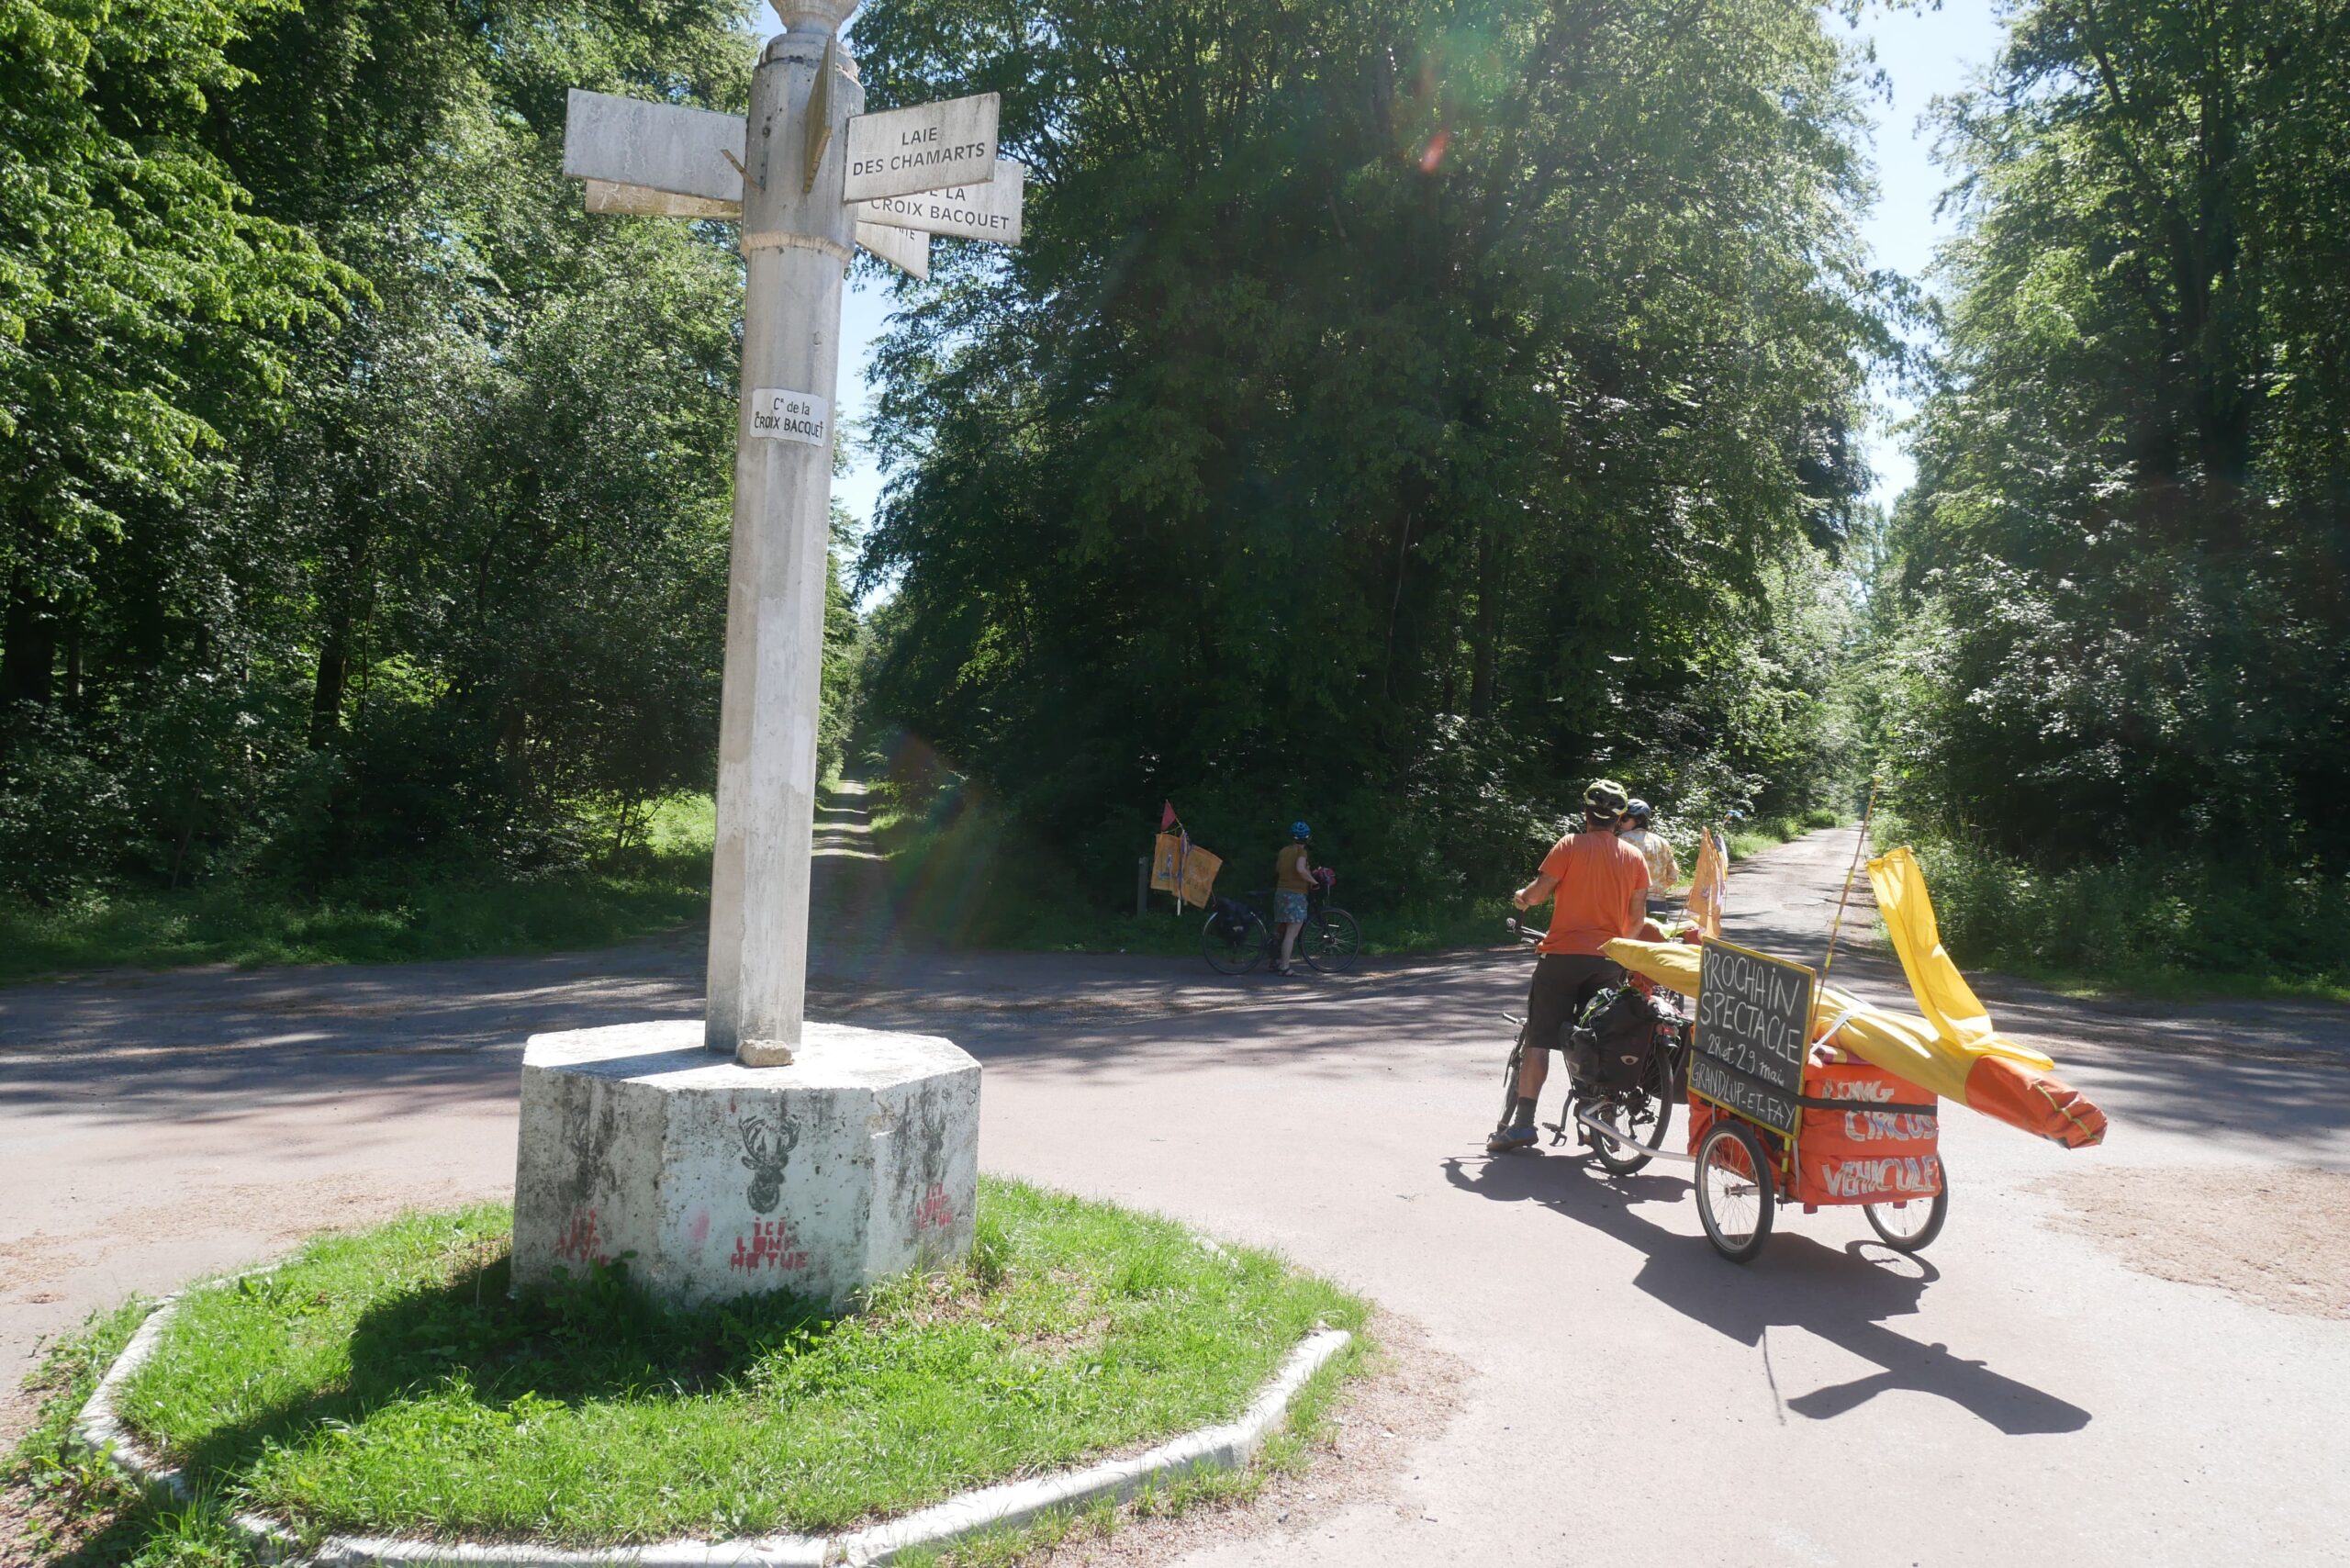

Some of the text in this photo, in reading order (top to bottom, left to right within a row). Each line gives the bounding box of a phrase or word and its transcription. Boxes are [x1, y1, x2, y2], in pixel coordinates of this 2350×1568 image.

[901, 127, 938, 146] LAIE
[853, 142, 985, 176] DES CHAMARTS
[946, 187, 967, 202] LA
[871, 197, 1010, 230] CROIX BACQUET
[787, 401, 800, 414] de
[801, 401, 810, 416] la
[754, 415, 823, 439] CROIX BACQUET
[1699, 991, 1801, 1065] SPECTACLE
[1737, 1043, 1756, 1074] 29
[1760, 1060, 1785, 1087] mai
[1822, 1079, 1895, 1103] LONG
[1844, 1110, 1938, 1142] CIRCUS
